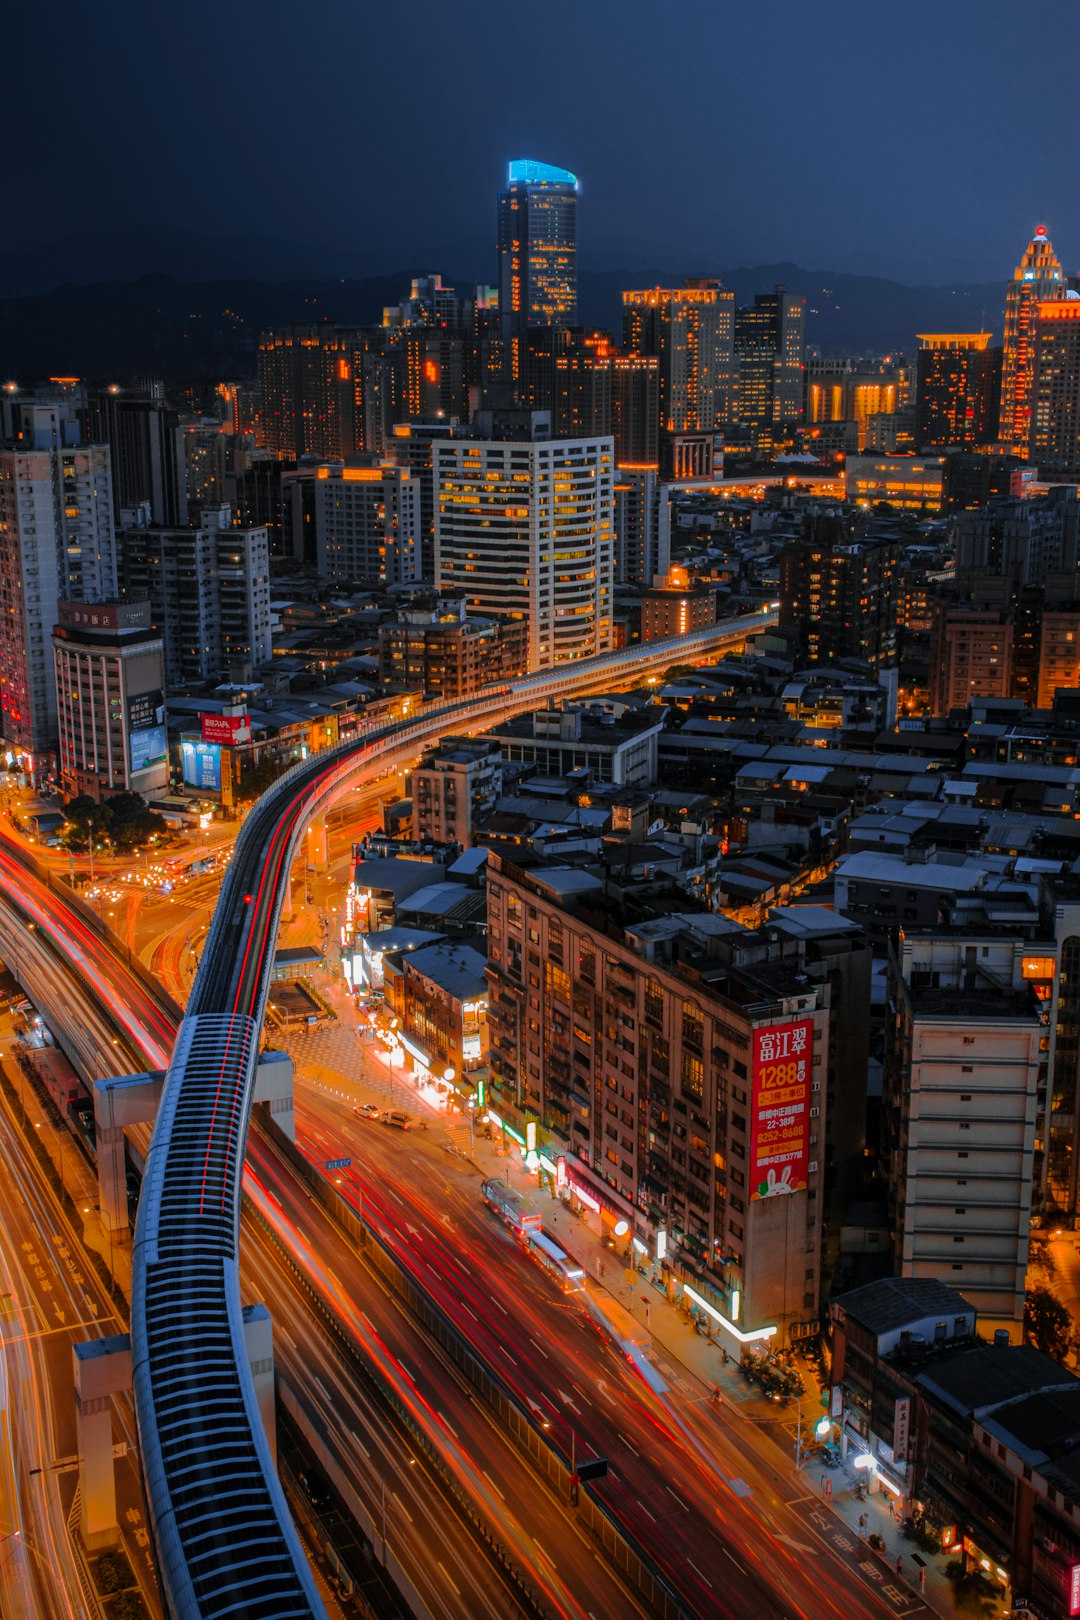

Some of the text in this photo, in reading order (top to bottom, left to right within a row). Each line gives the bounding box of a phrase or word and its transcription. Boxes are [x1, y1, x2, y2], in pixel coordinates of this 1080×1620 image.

[759, 1026, 807, 1062] 富江翠
[758, 1062, 798, 1089] 1288
